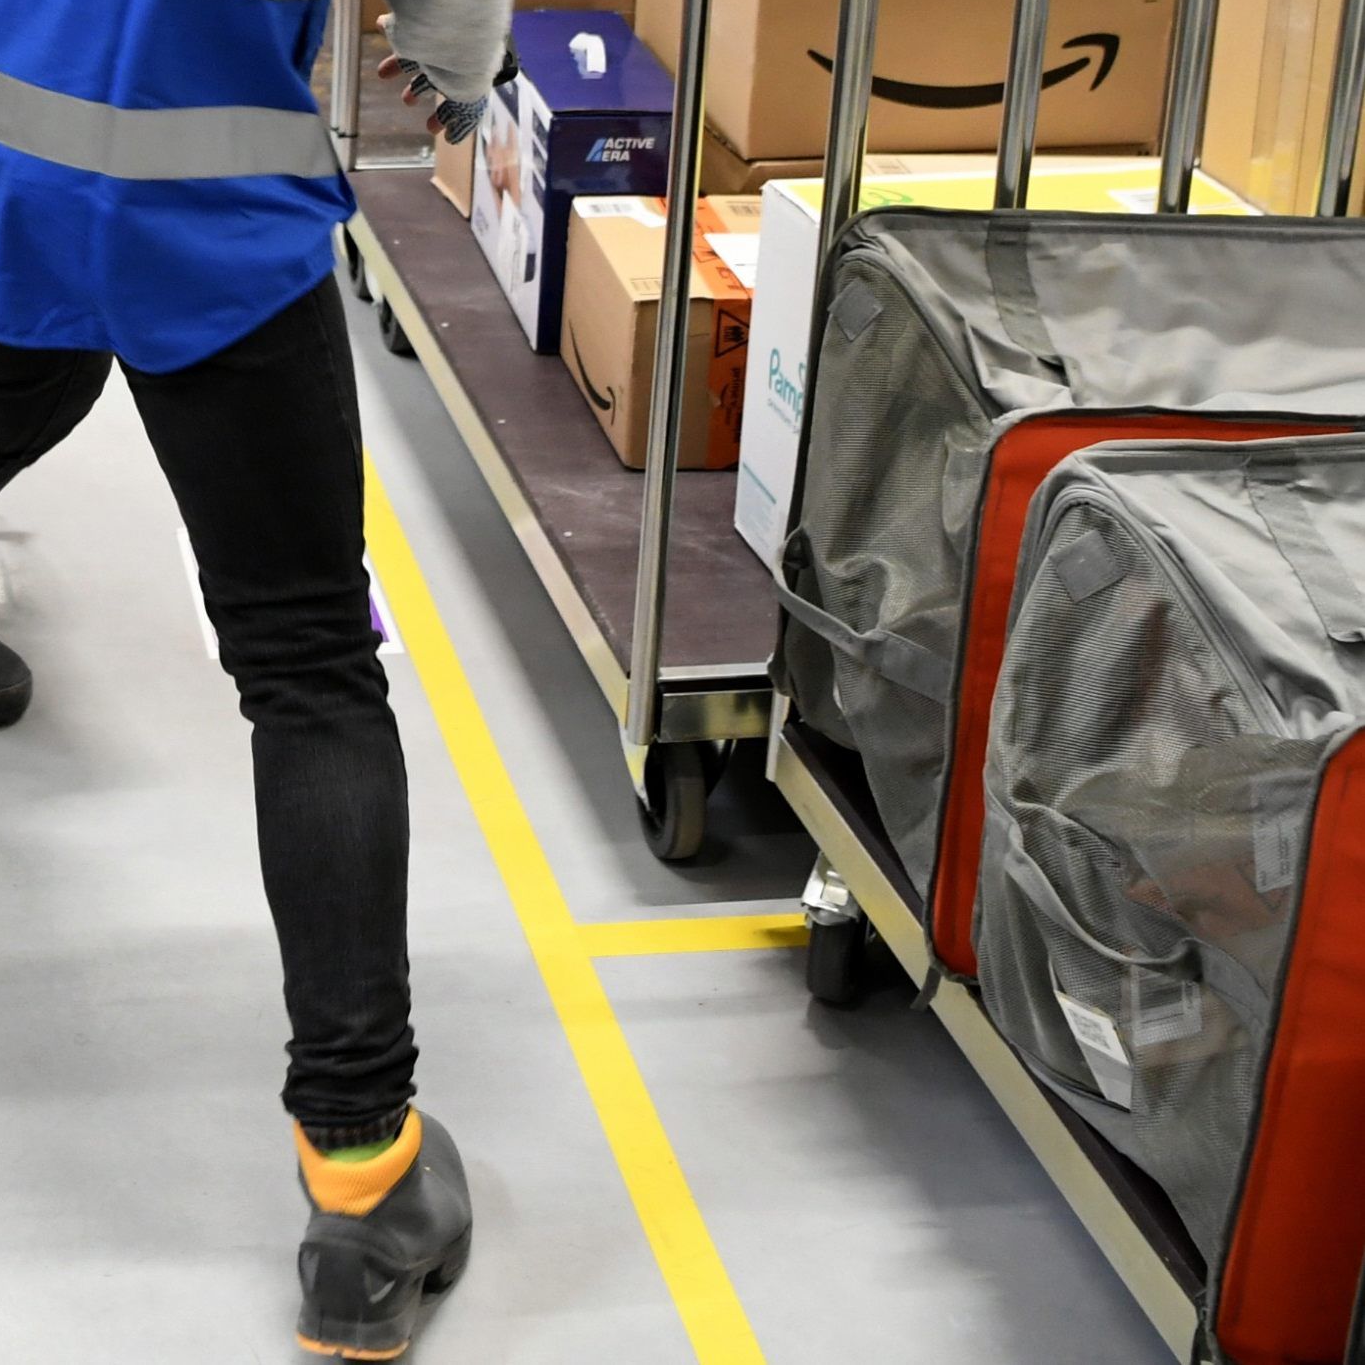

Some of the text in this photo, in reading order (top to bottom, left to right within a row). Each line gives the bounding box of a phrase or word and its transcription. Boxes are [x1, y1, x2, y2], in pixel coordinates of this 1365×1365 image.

[604, 137, 655, 150] ACTIVE
[601, 150, 631, 163] ERA
[768, 346, 803, 423] Pamp
